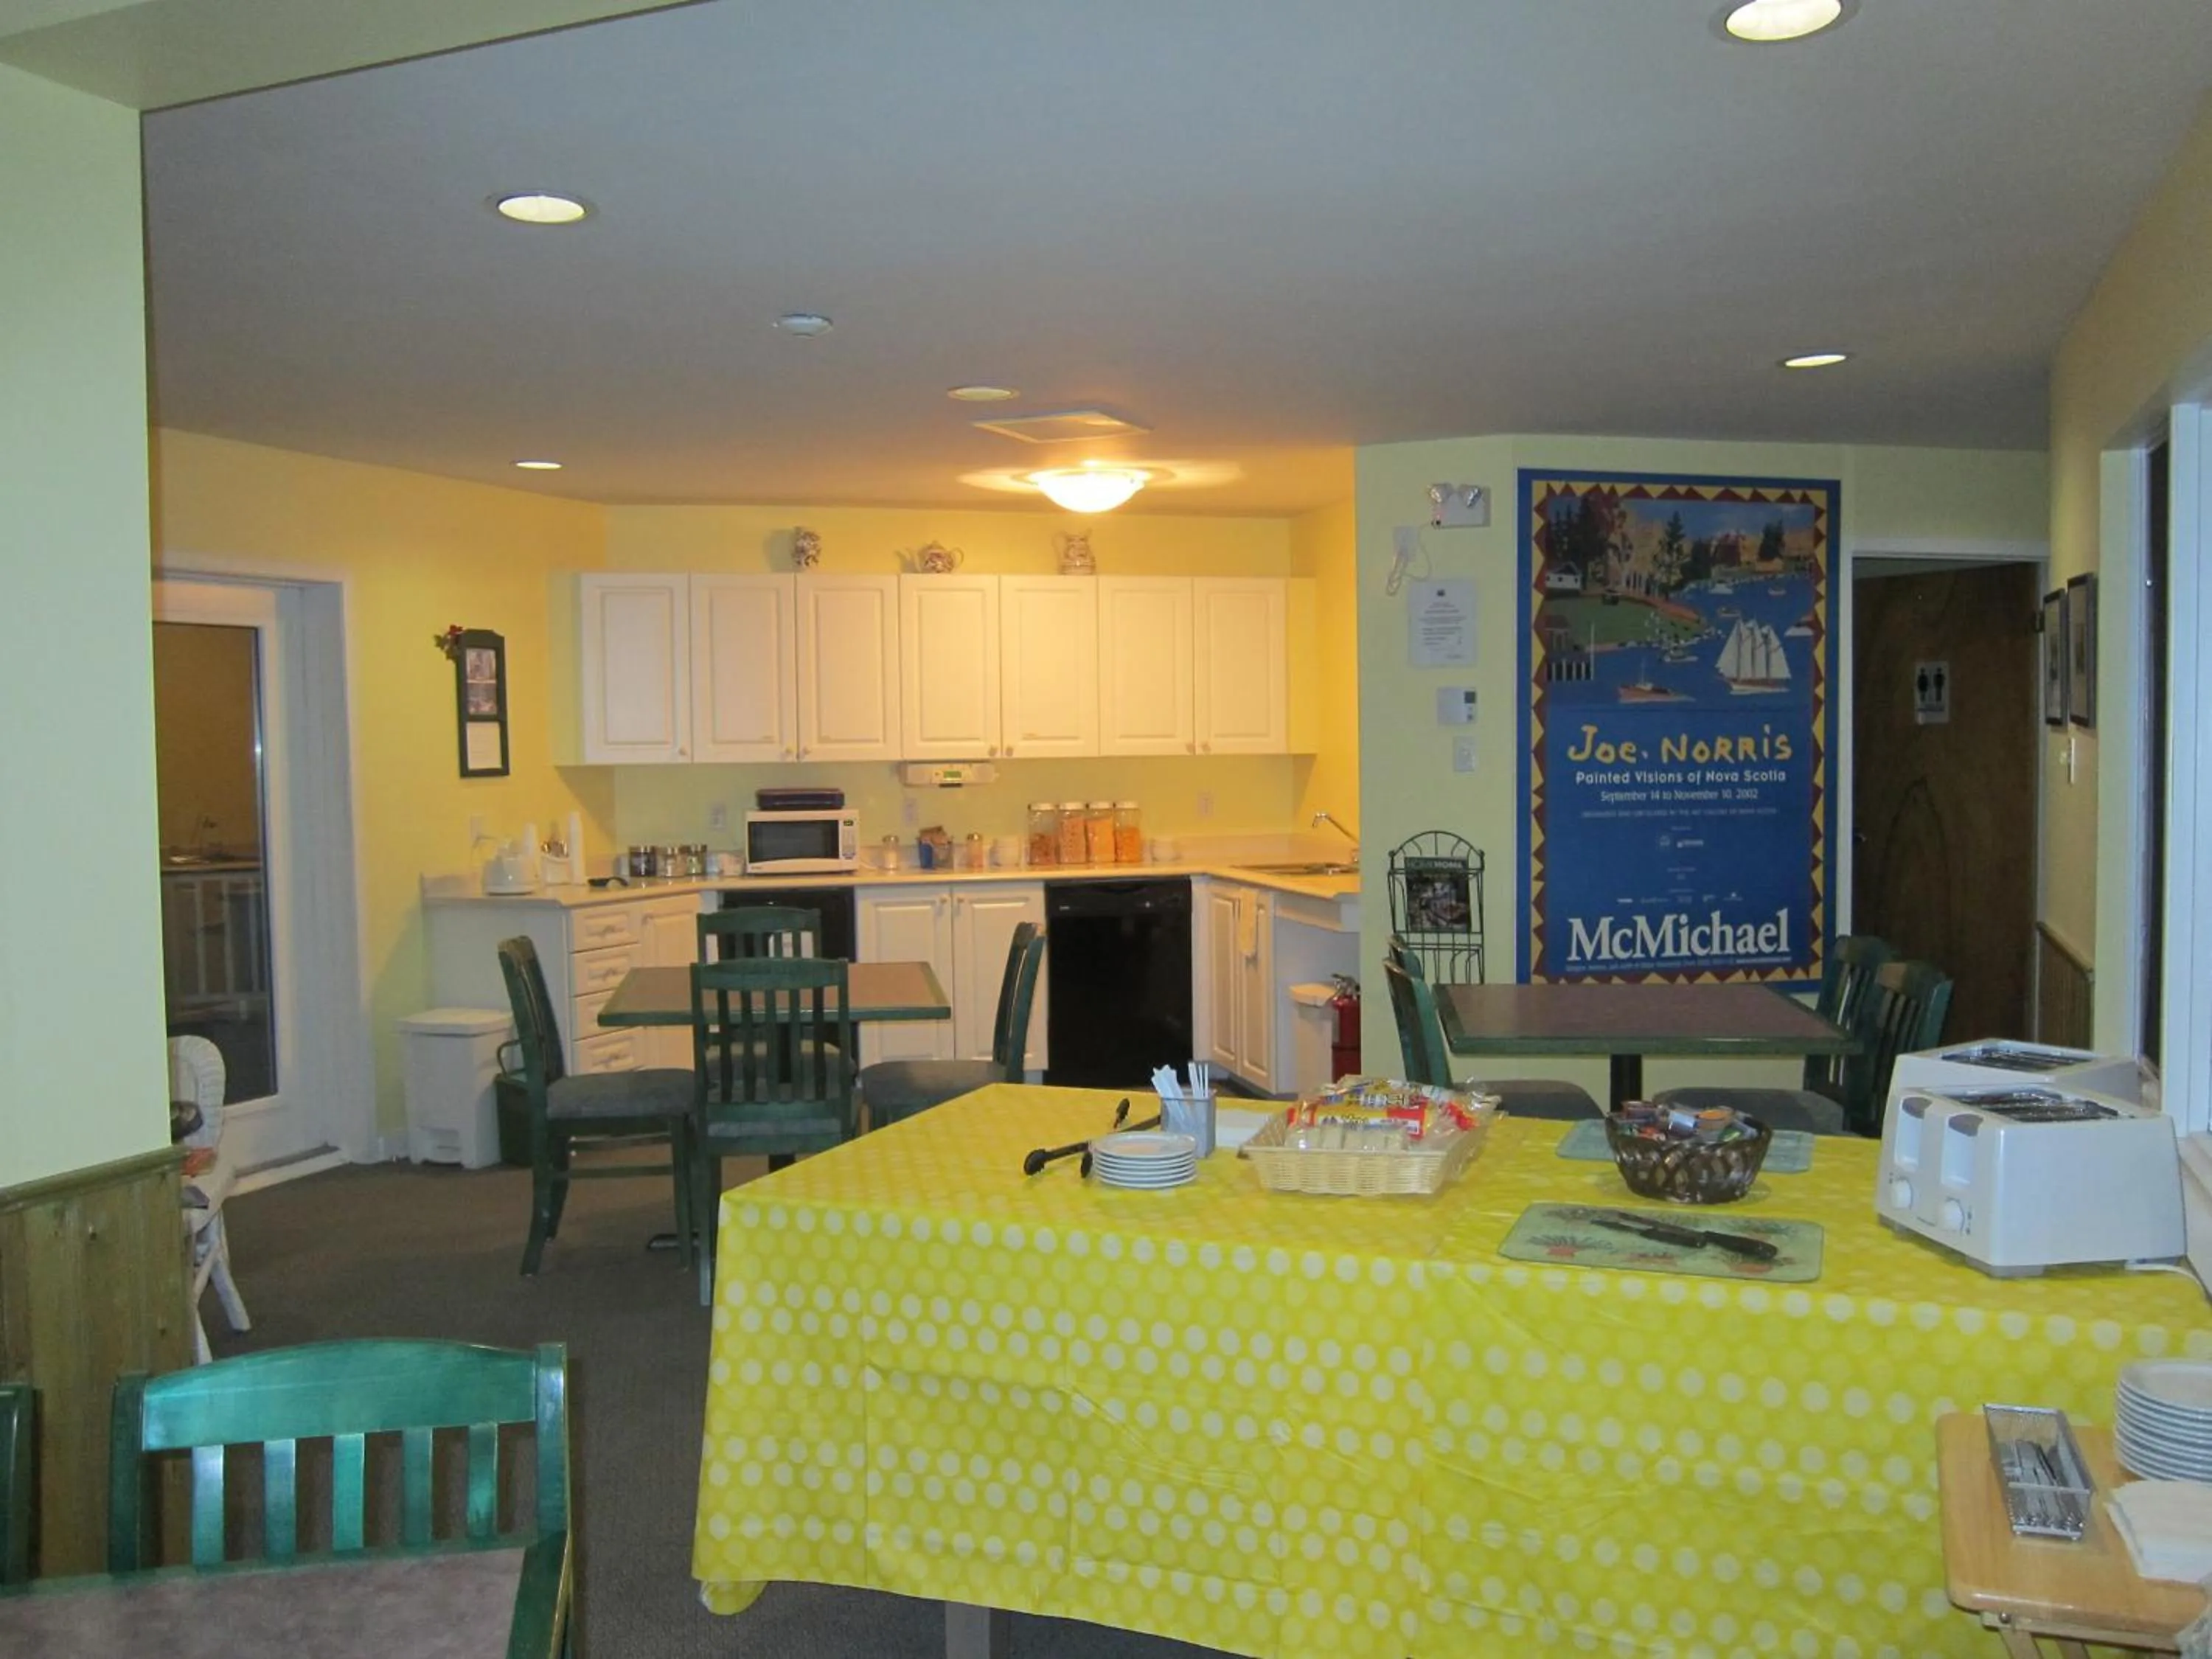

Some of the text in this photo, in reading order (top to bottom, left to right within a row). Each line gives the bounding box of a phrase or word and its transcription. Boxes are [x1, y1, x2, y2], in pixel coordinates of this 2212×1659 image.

[1576, 769, 1787, 785] Painted Visions of Nova Scotia
[1601, 790, 1647, 804] September
[1662, 790, 1672, 800] to
[1674, 789, 1719, 801] November
[1736, 787, 1759, 799] 2002
[1567, 908, 1790, 961] McMichael
